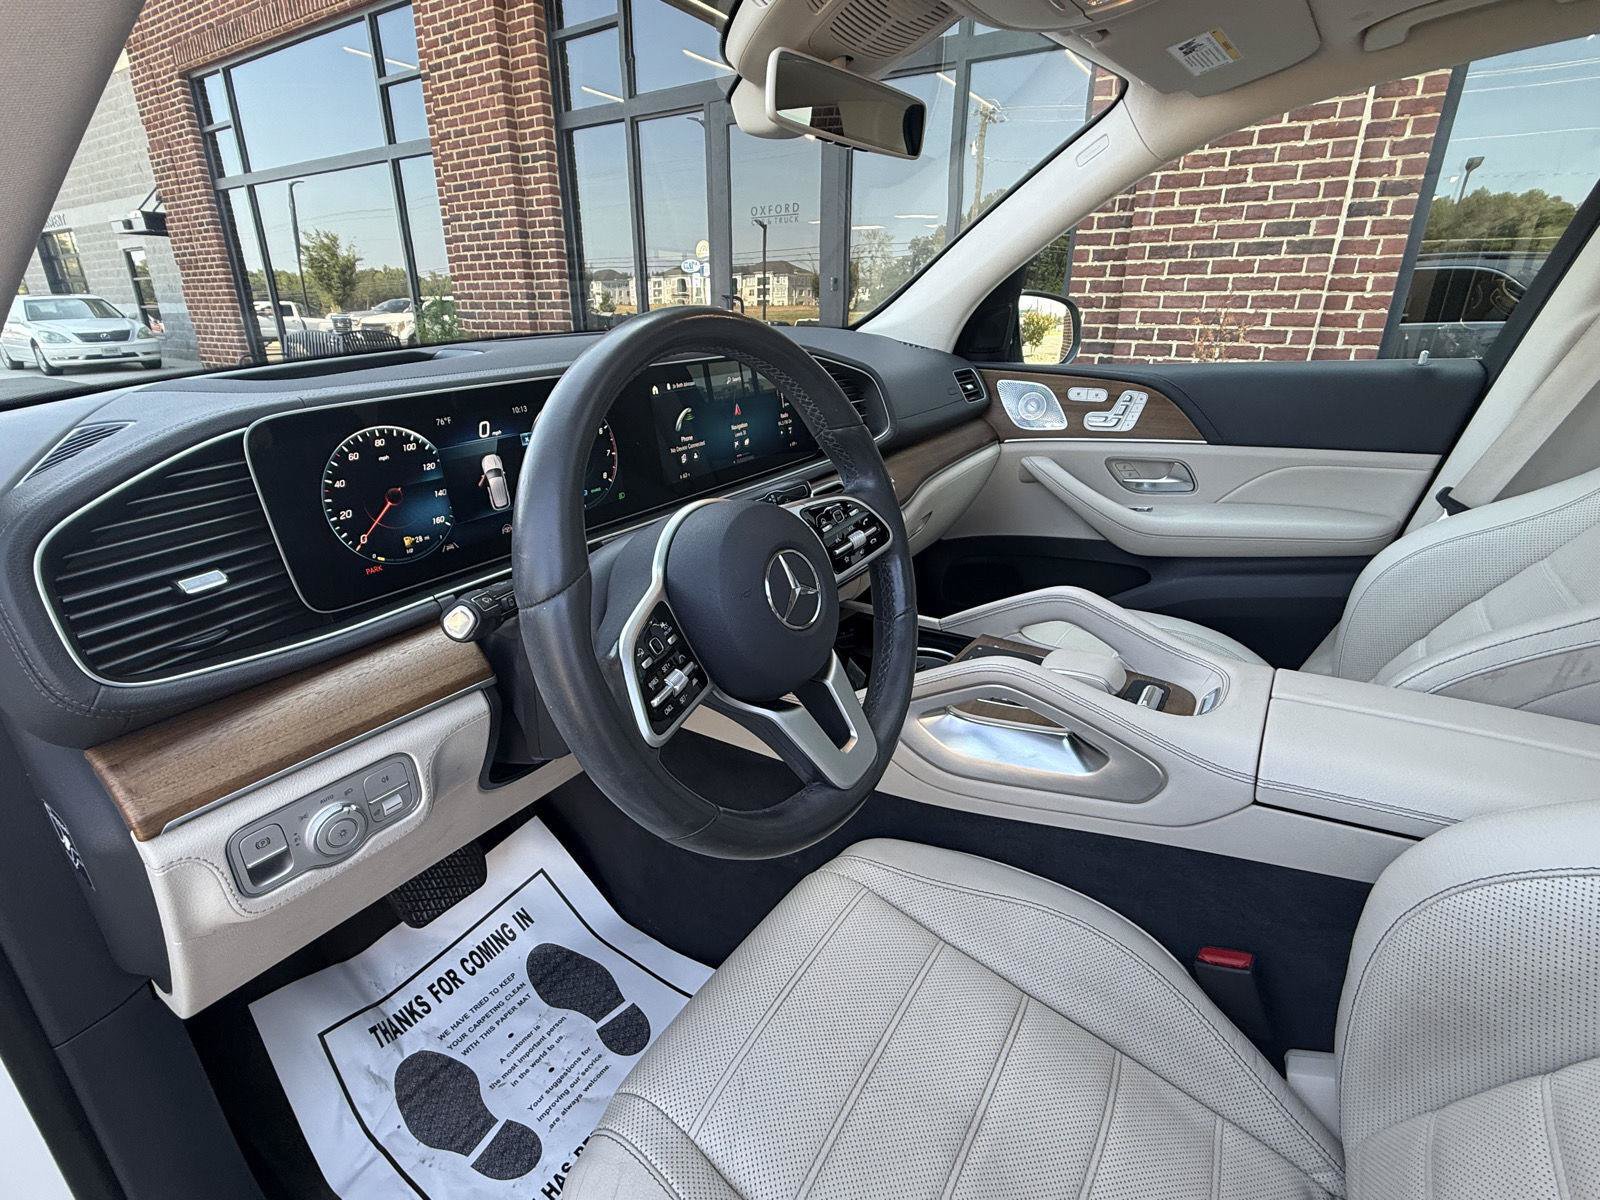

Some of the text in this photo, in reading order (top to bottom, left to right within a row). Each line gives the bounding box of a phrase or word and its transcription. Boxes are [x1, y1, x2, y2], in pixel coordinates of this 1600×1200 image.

[750, 203, 800, 216] OXFORD
[511, 405, 528, 414] 10:13
[478, 420, 490, 438] 0
[374, 438, 385, 448] 80
[402, 442, 417, 452] 100
[348, 451, 360, 462] 60
[606, 449, 611, 457] 7
[422, 462, 436, 471] 120
[333, 479, 346, 489] 40
[434, 488, 447, 498] 140
[339, 509, 353, 520] 20
[432, 515, 445, 525] 160
[365, 564, 383, 576] PARK
[368, 906, 535, 1049] THANKS FOR COMING IN
[437, 972, 516, 1041] WE HAVE TRIED TO KEEP
[447, 981, 526, 1051] YOUR CARPETING CLEAN
[461, 992, 532, 1056] WITH THIS PAPER MAT
[499, 1024, 541, 1065] A customer is
[489, 1016, 567, 1090] the most important person
[510, 1080, 519, 1088] in
[518, 1068, 530, 1080] the
[530, 1050, 548, 1068] world
[527, 1046, 591, 1111] Your suggestions for
[536, 1053, 603, 1122] improving our service
[548, 1117, 560, 1130] are
[561, 1093, 583, 1116] always
